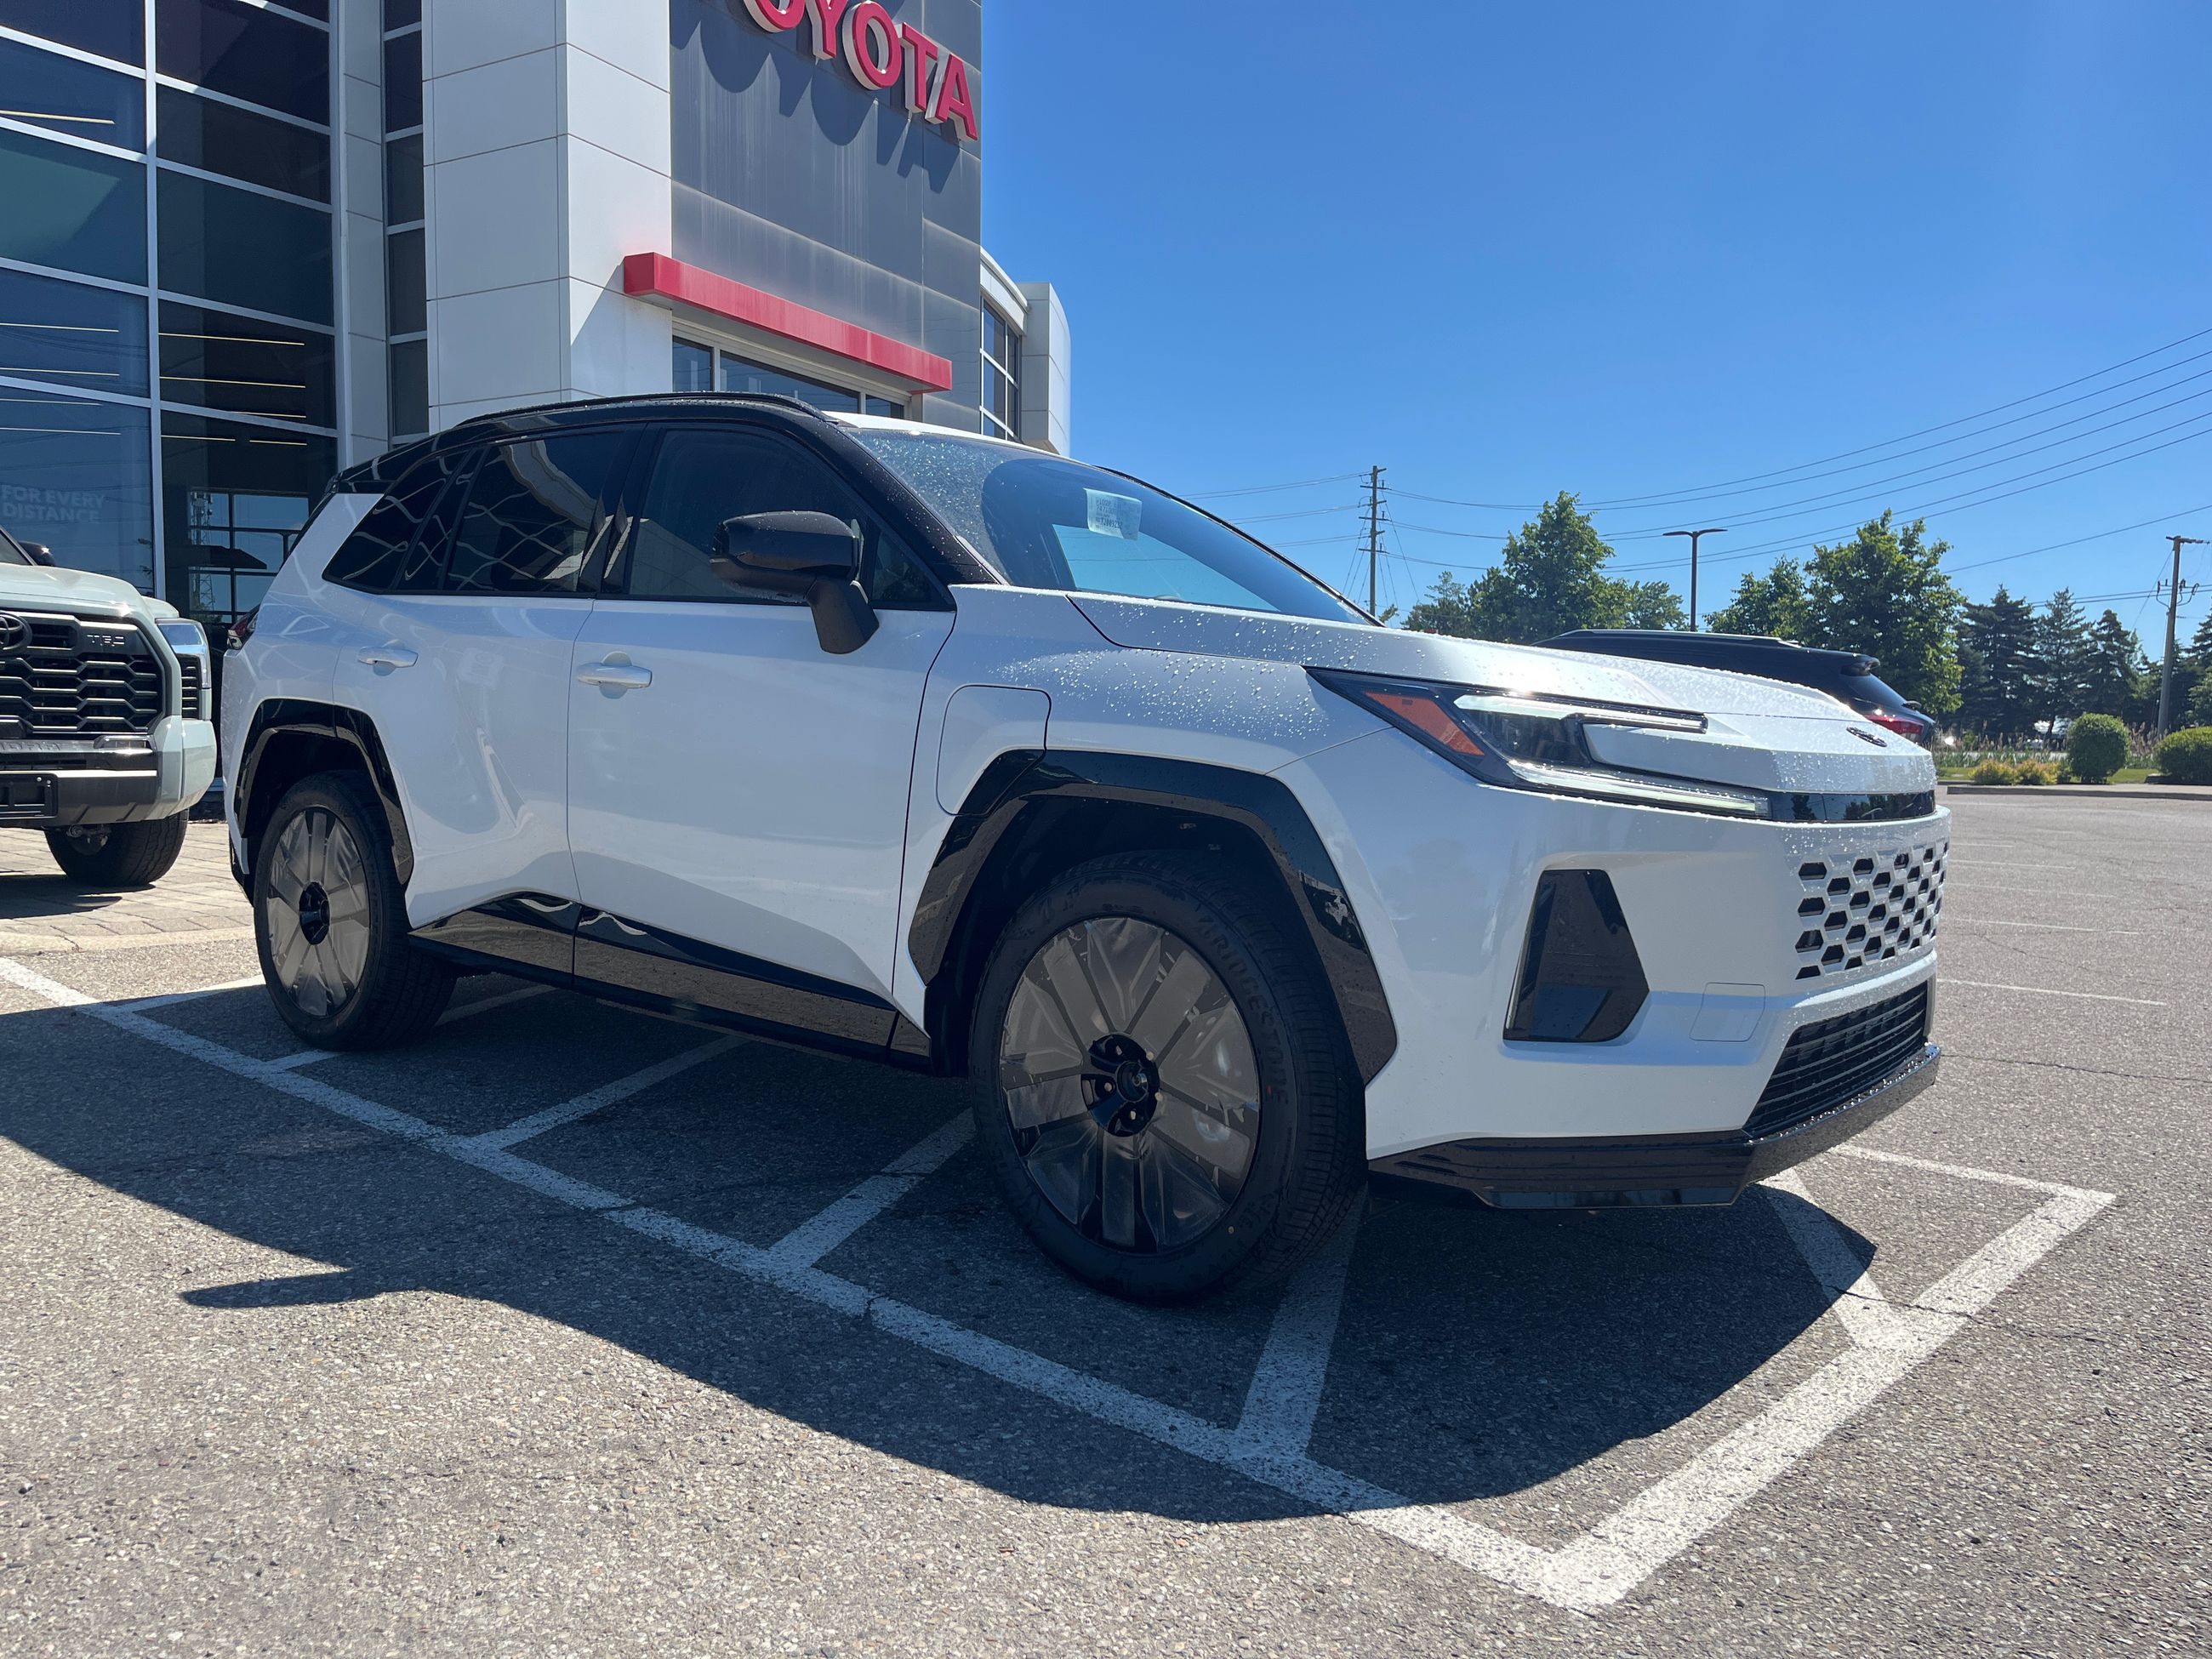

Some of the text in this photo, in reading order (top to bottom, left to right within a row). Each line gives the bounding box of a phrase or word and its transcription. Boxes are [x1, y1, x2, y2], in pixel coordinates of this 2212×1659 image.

[2, 485, 105, 509] FOR EVERY
[3, 503, 100, 527] DISTANCE
